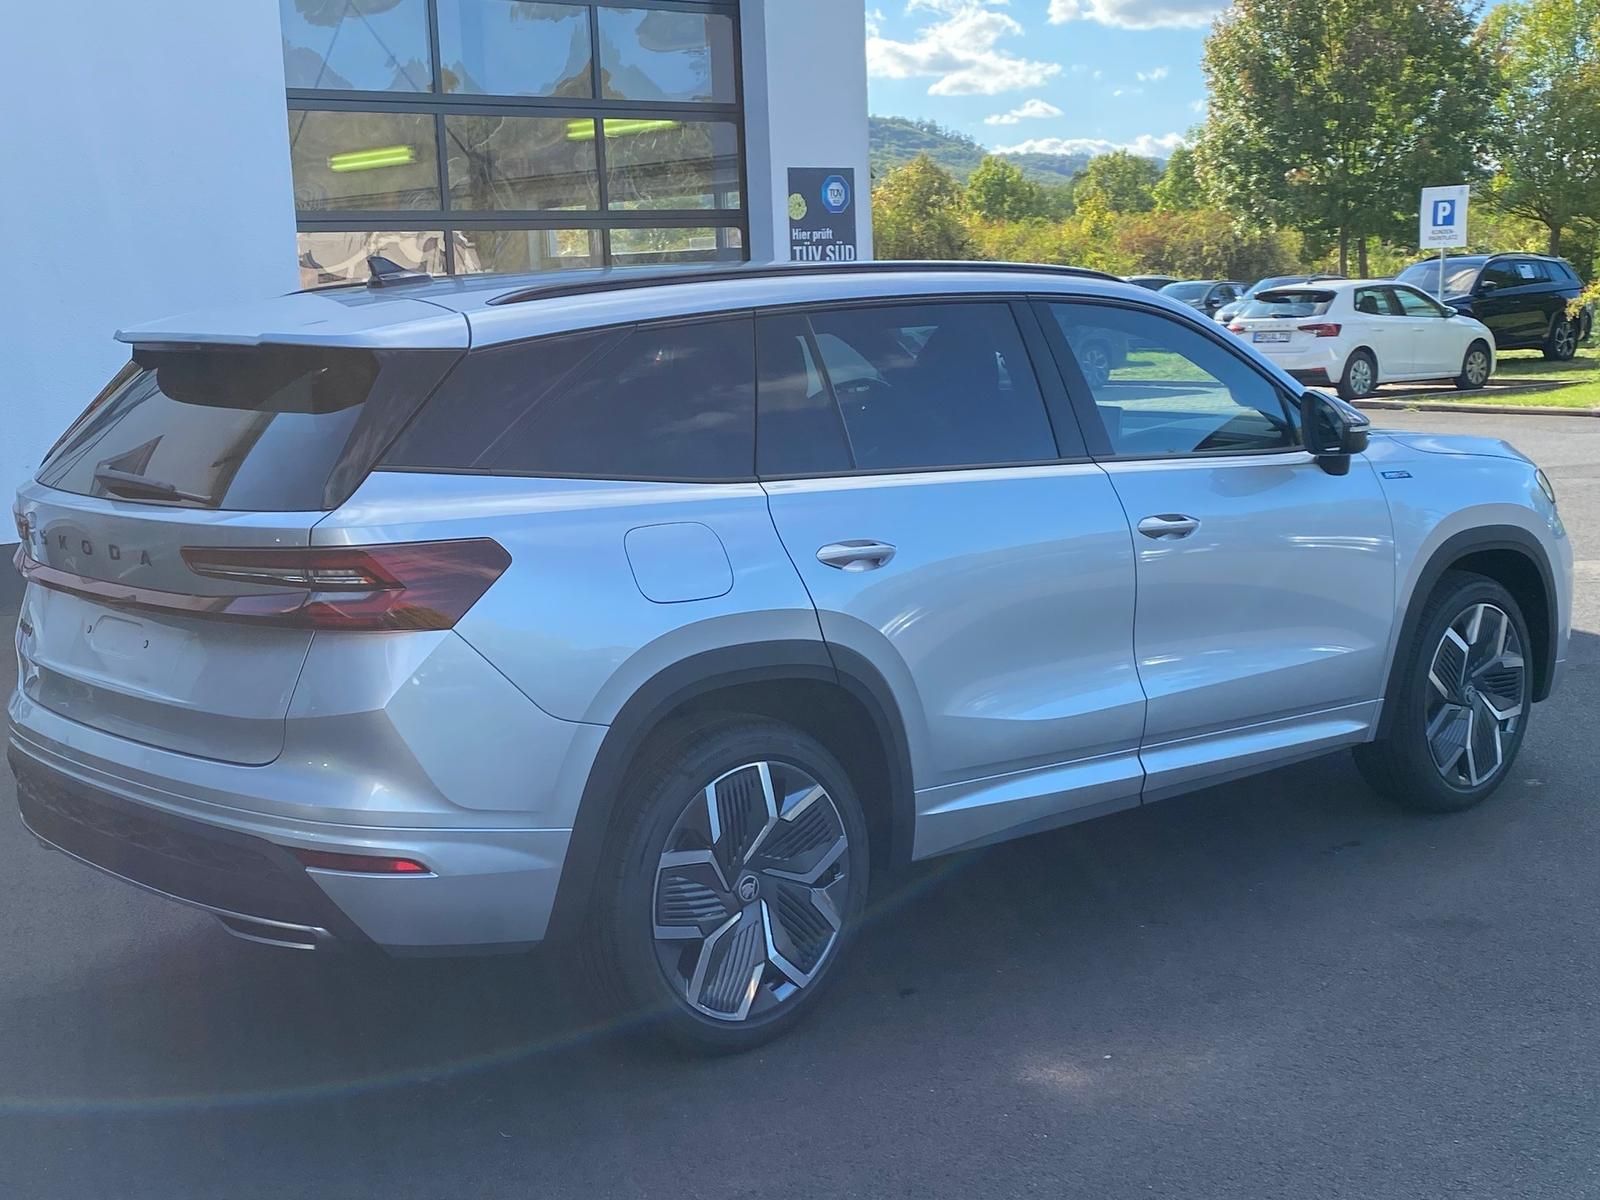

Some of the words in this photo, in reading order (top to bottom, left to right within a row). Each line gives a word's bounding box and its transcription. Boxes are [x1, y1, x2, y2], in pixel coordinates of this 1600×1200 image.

[1437, 201, 1452, 225] P
[792, 228, 811, 240] Hier
[812, 227, 833, 243] prüft
[793, 241, 822, 261] TÜV
[826, 240, 855, 261] SÜD
